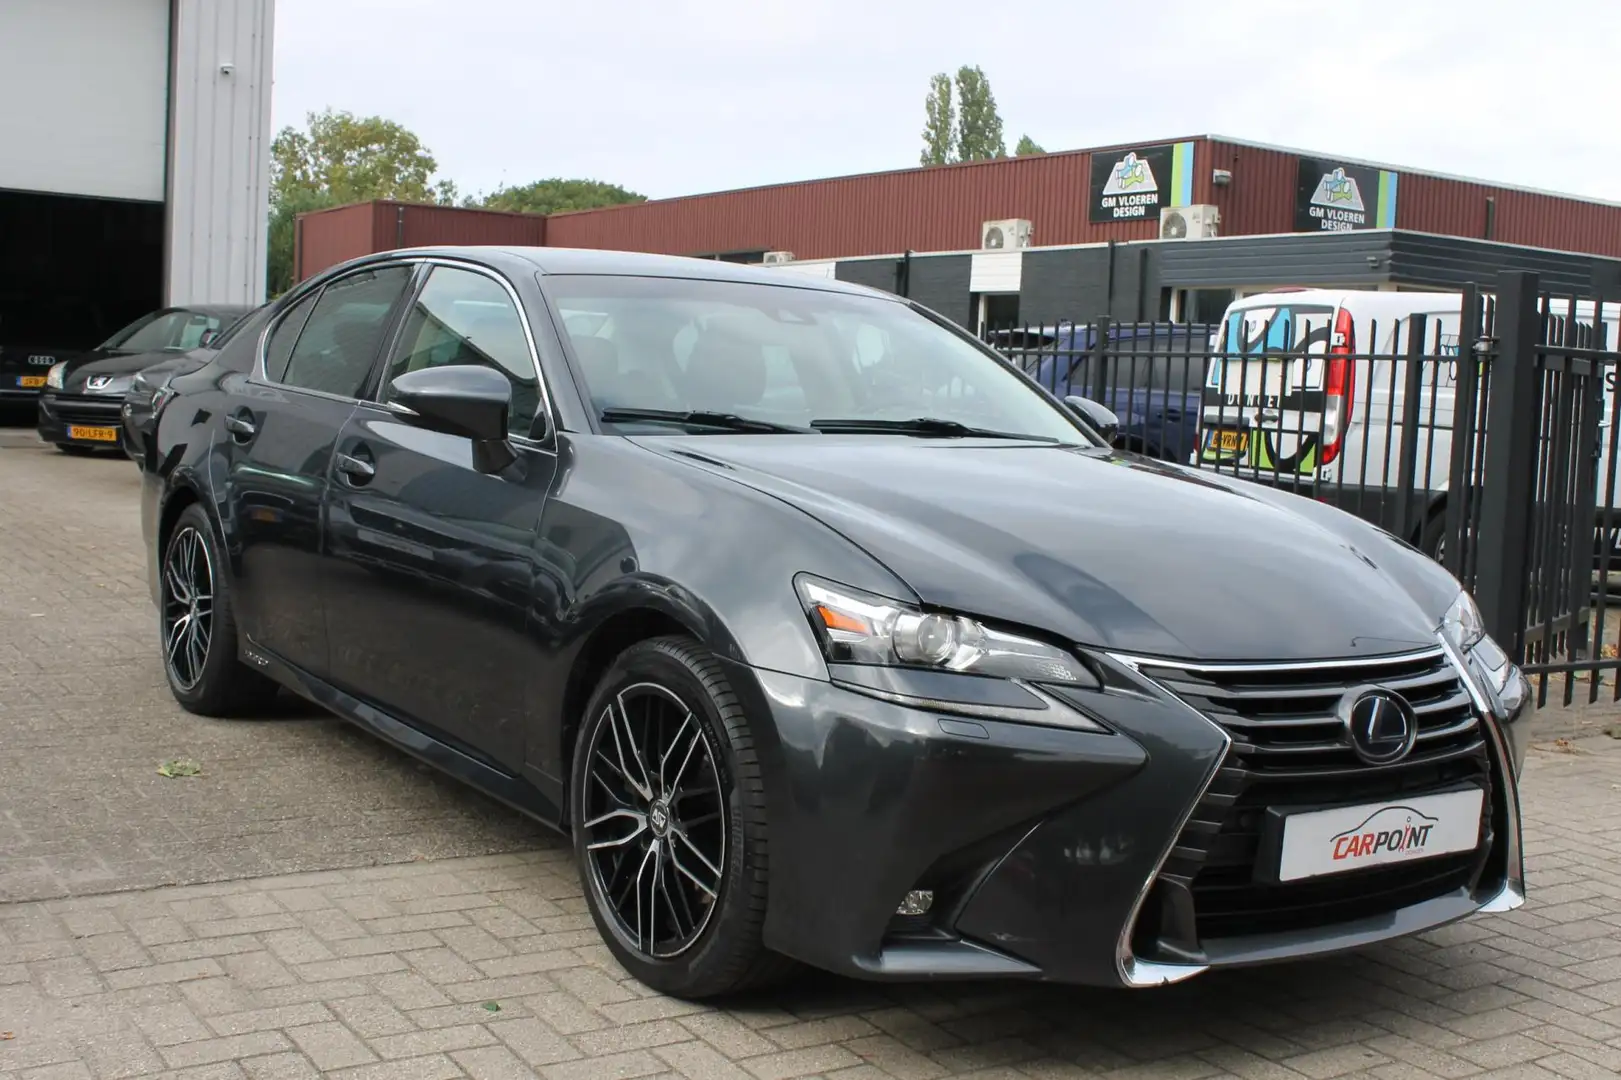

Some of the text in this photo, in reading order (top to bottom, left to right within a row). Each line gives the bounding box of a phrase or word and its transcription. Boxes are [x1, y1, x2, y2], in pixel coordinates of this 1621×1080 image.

[1101, 193, 1159, 208] GM VLOEREN
[1113, 206, 1146, 218] DESIGN
[1309, 206, 1365, 224] GM VLOEREN
[1321, 219, 1353, 231] DESIGN
[1333, 824, 1434, 860] CARPOINT
